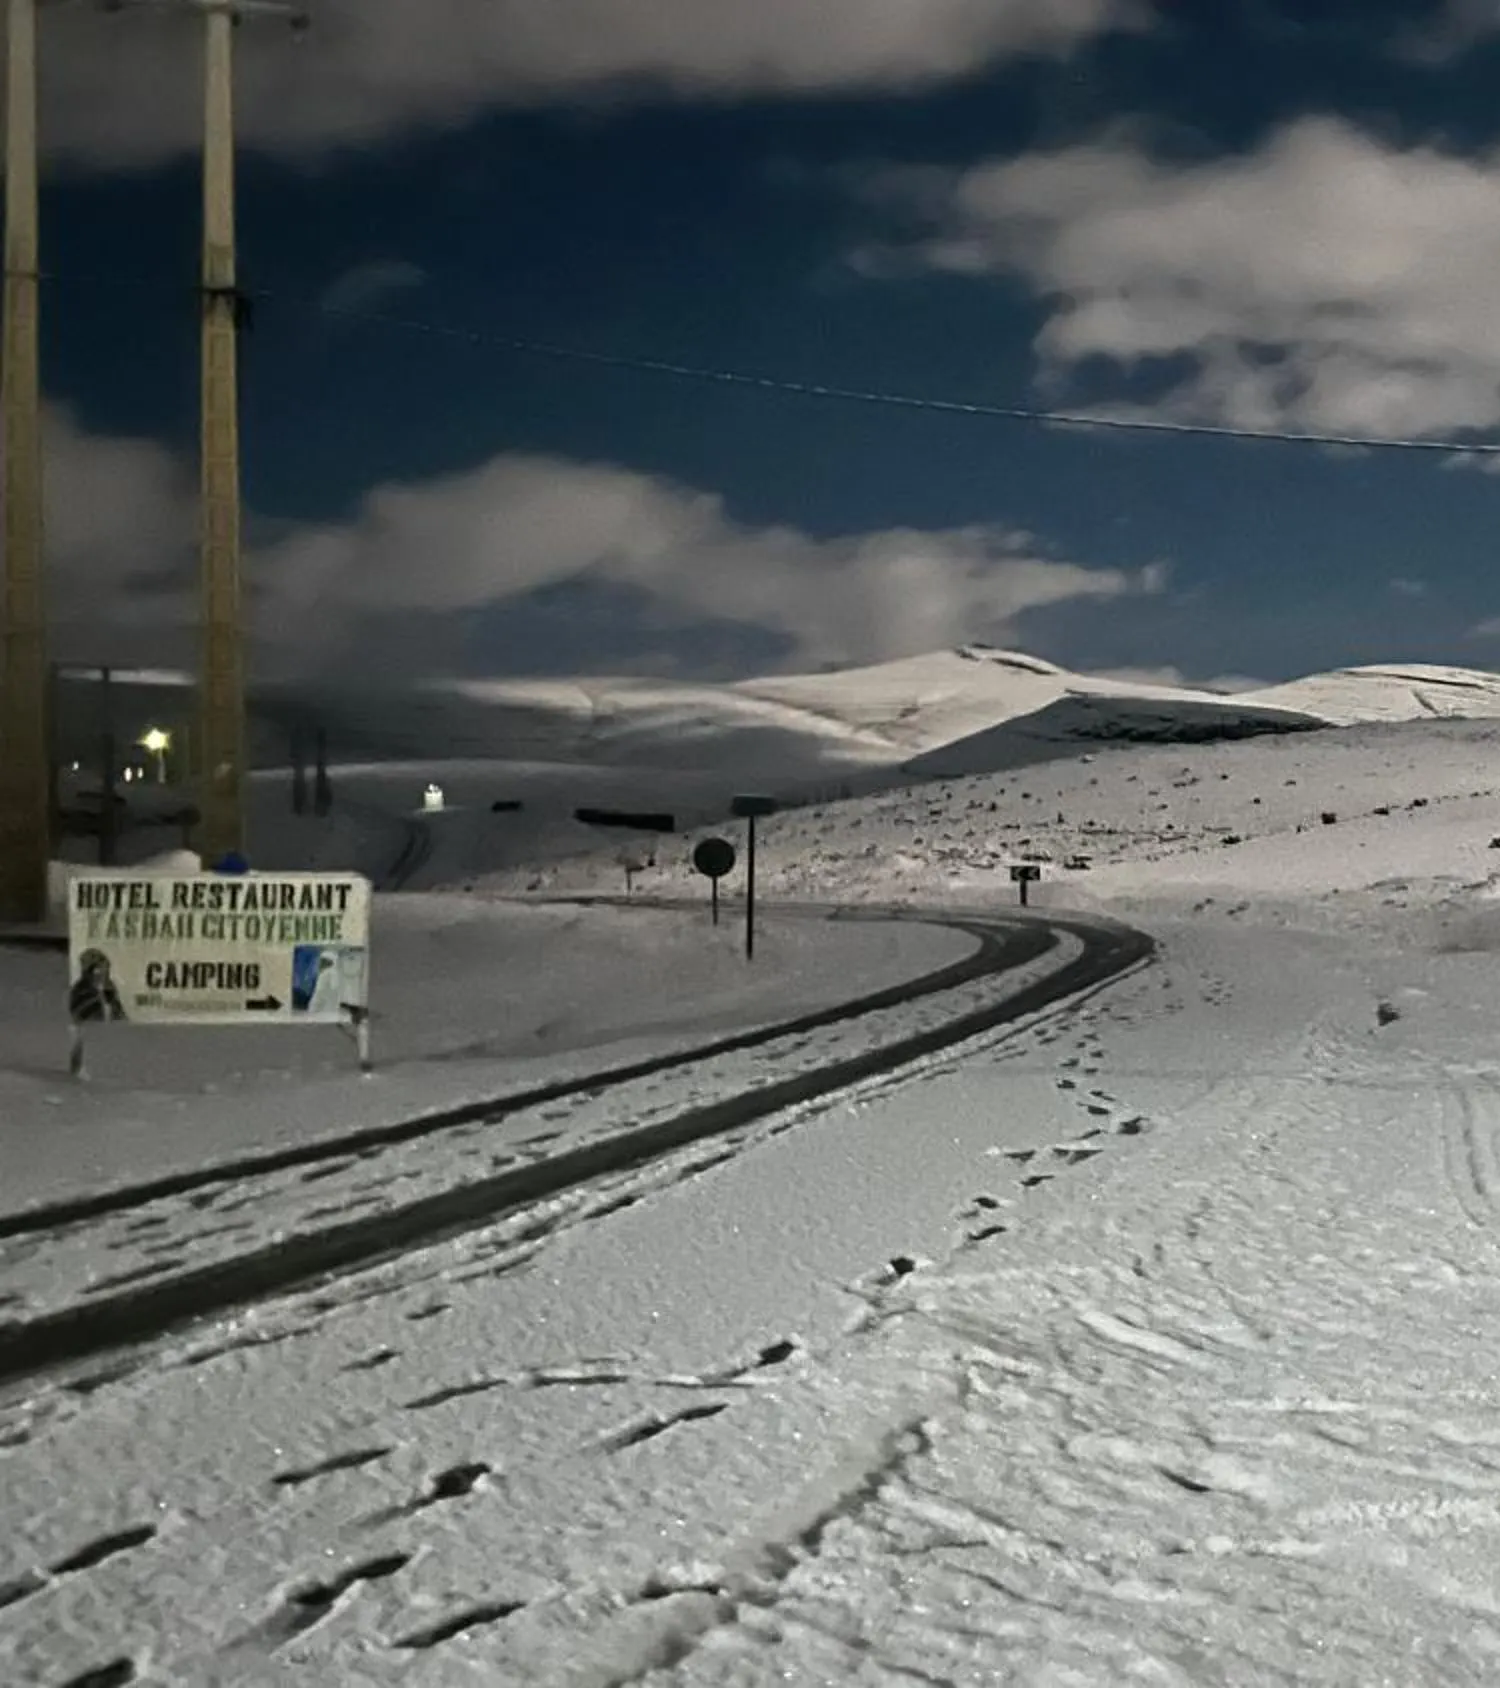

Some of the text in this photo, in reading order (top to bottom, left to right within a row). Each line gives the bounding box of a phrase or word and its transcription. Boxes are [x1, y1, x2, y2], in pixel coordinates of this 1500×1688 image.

[77, 881, 352, 910] HOTEL RESTAURANT
[201, 913, 343, 940] CITOYENNE
[146, 961, 259, 989] CAMPING
